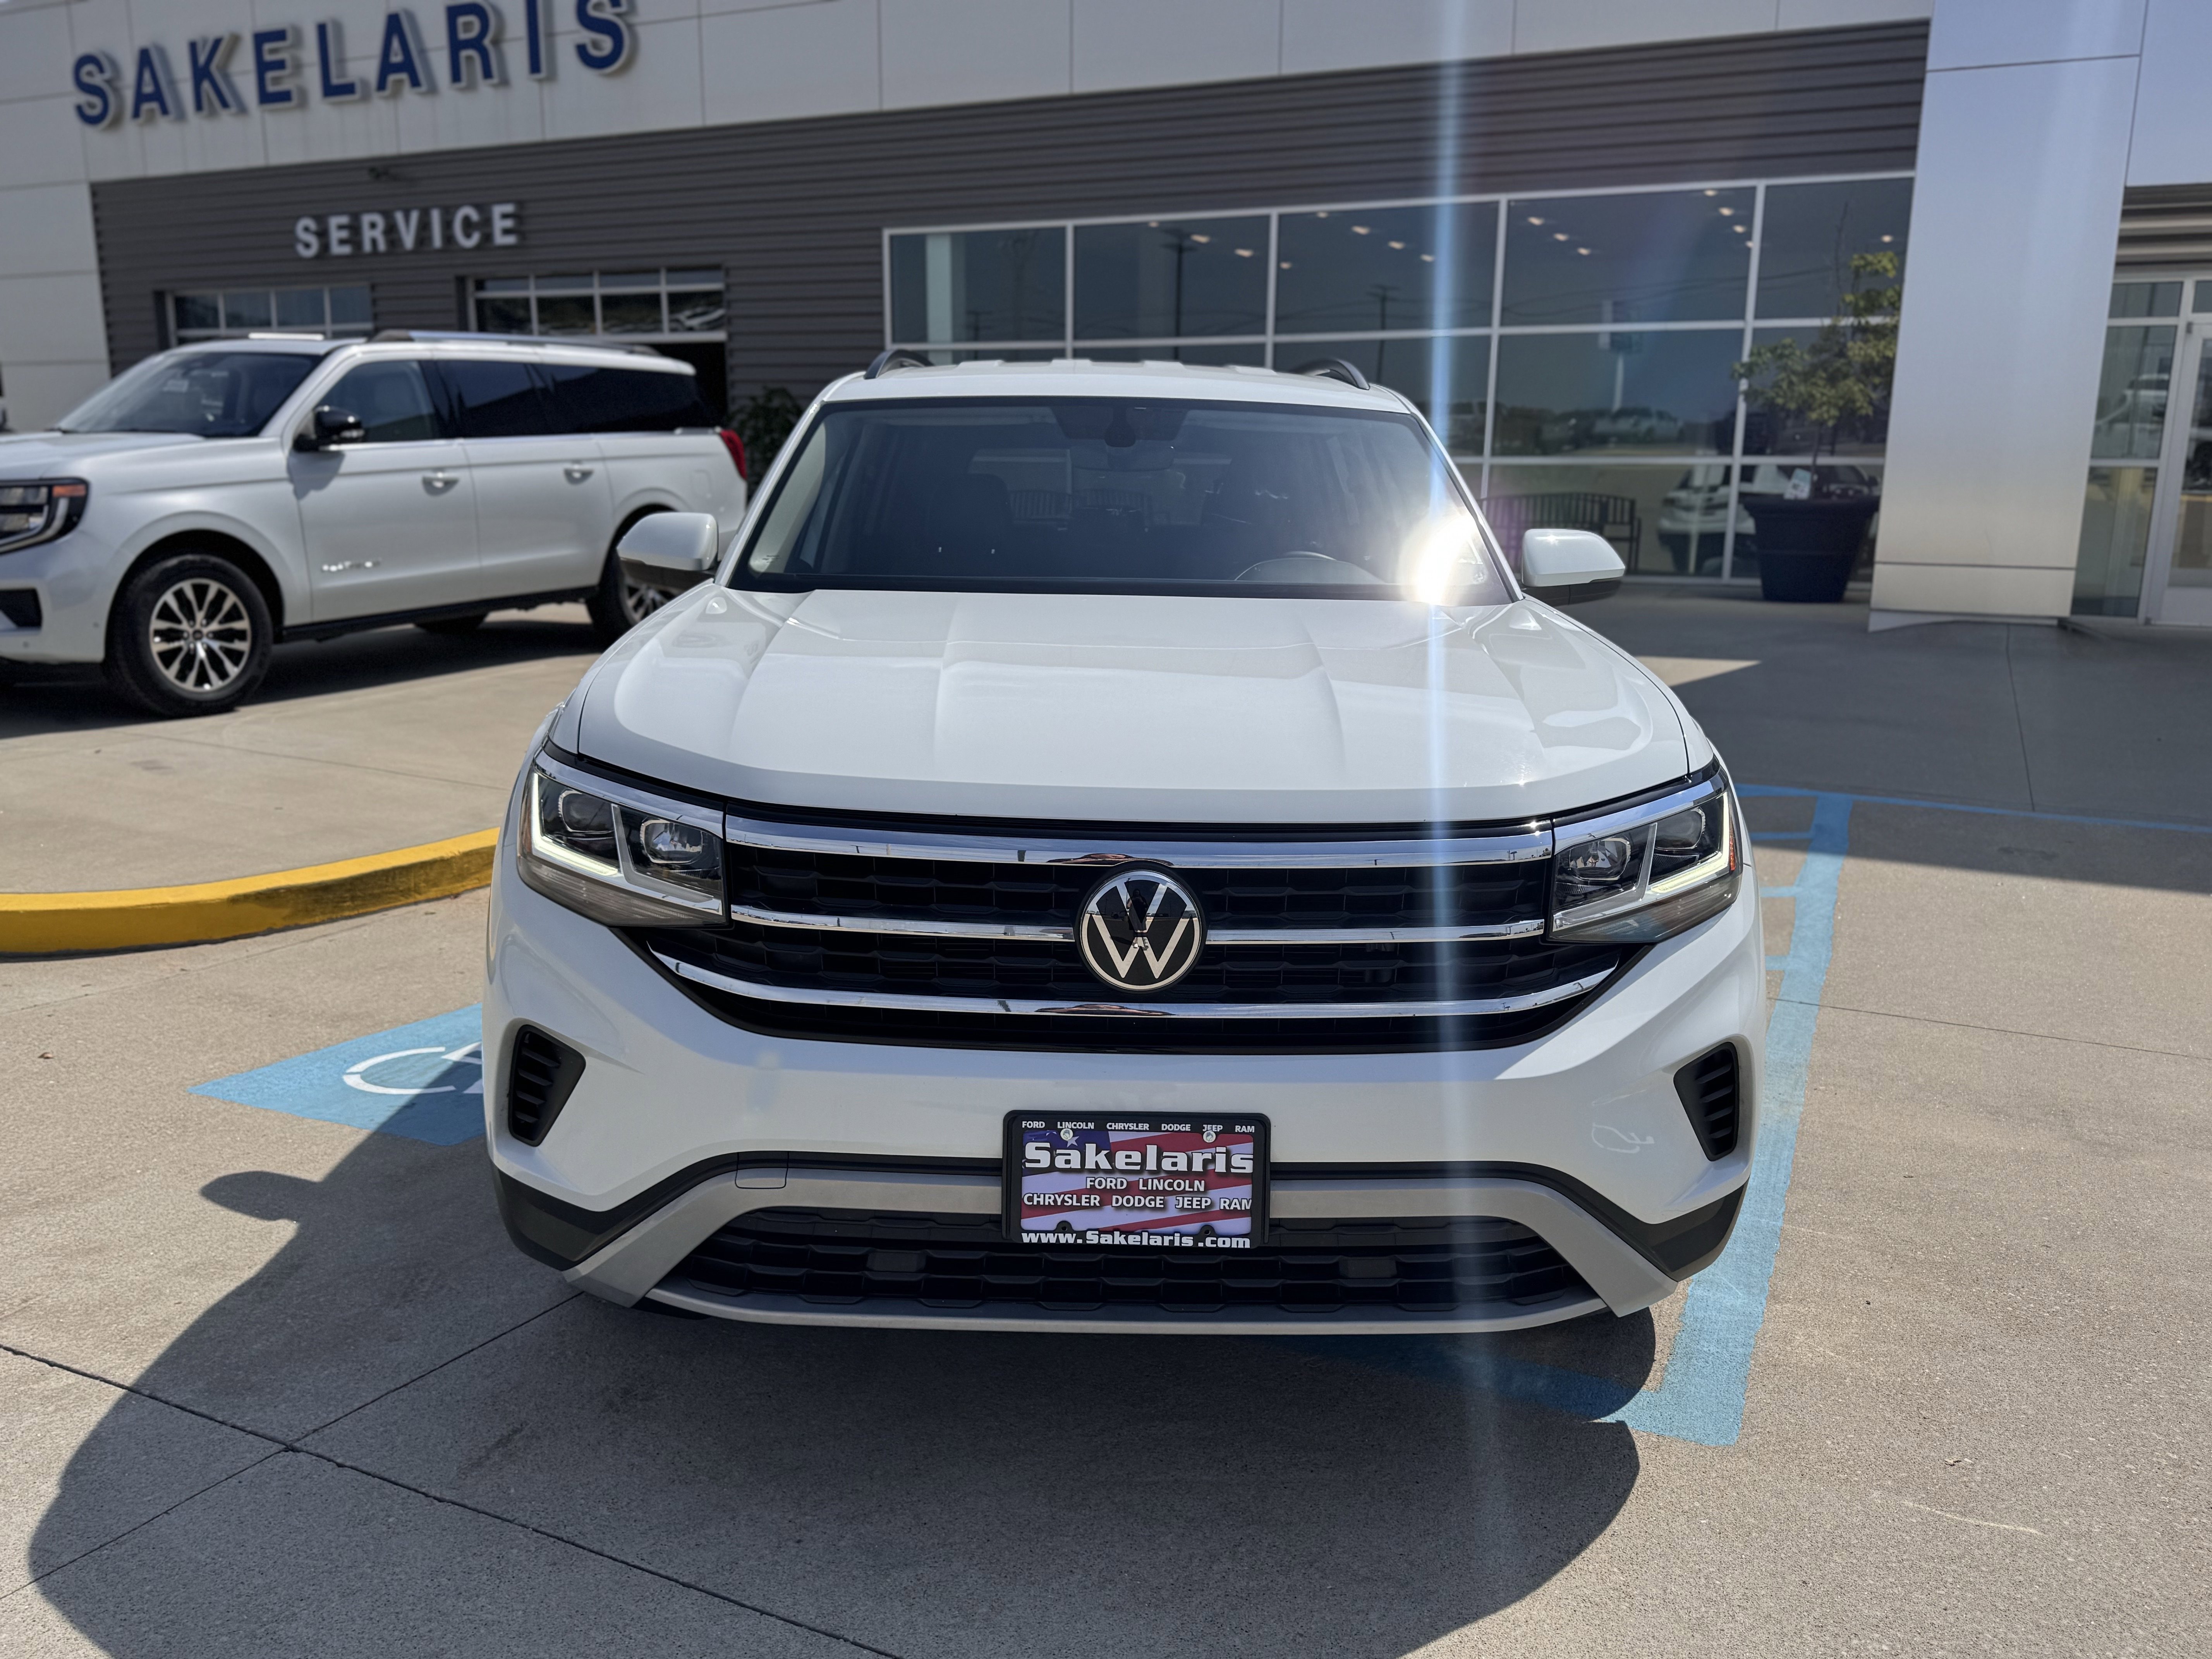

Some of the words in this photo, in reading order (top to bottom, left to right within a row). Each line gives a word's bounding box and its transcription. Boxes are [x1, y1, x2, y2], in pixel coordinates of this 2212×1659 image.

[74, 0, 631, 126] SAKELARIS
[295, 202, 520, 258] SERVICE
[1025, 1142, 1254, 1173] Sakelaris
[1086, 1177, 1127, 1189] FORD
[1139, 1178, 1205, 1192] LINCOLN
[1023, 1193, 1100, 1206] CHRYSLER
[1112, 1195, 1164, 1208] DODGE
[1175, 1197, 1212, 1209] JEEP
